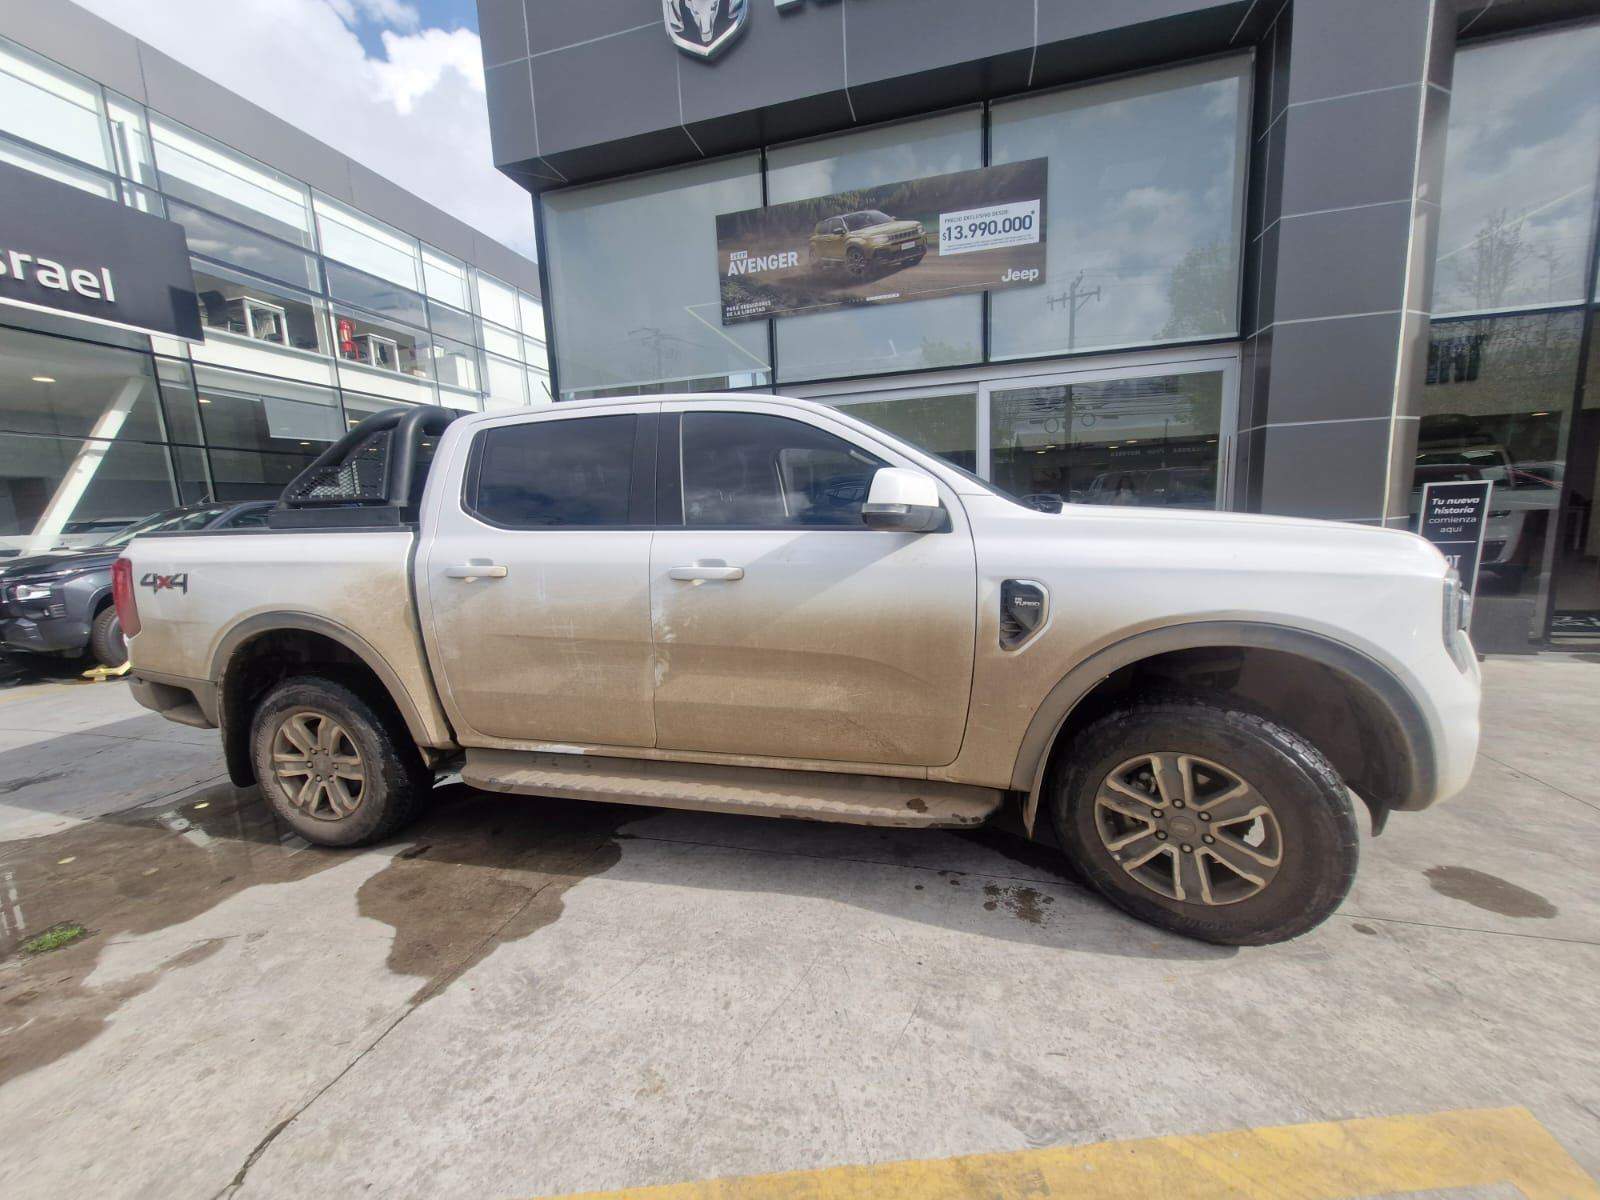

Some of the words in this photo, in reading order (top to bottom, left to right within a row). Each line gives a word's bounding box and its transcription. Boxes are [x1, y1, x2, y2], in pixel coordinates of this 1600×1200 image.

[727, 250, 799, 276] AVENGER
[1001, 268, 1040, 282] Jeep
[1431, 498, 1445, 506] Tu
[1446, 497, 1480, 505] nueva
[1434, 506, 1475, 515] historia
[1429, 517, 1477, 525] comienza
